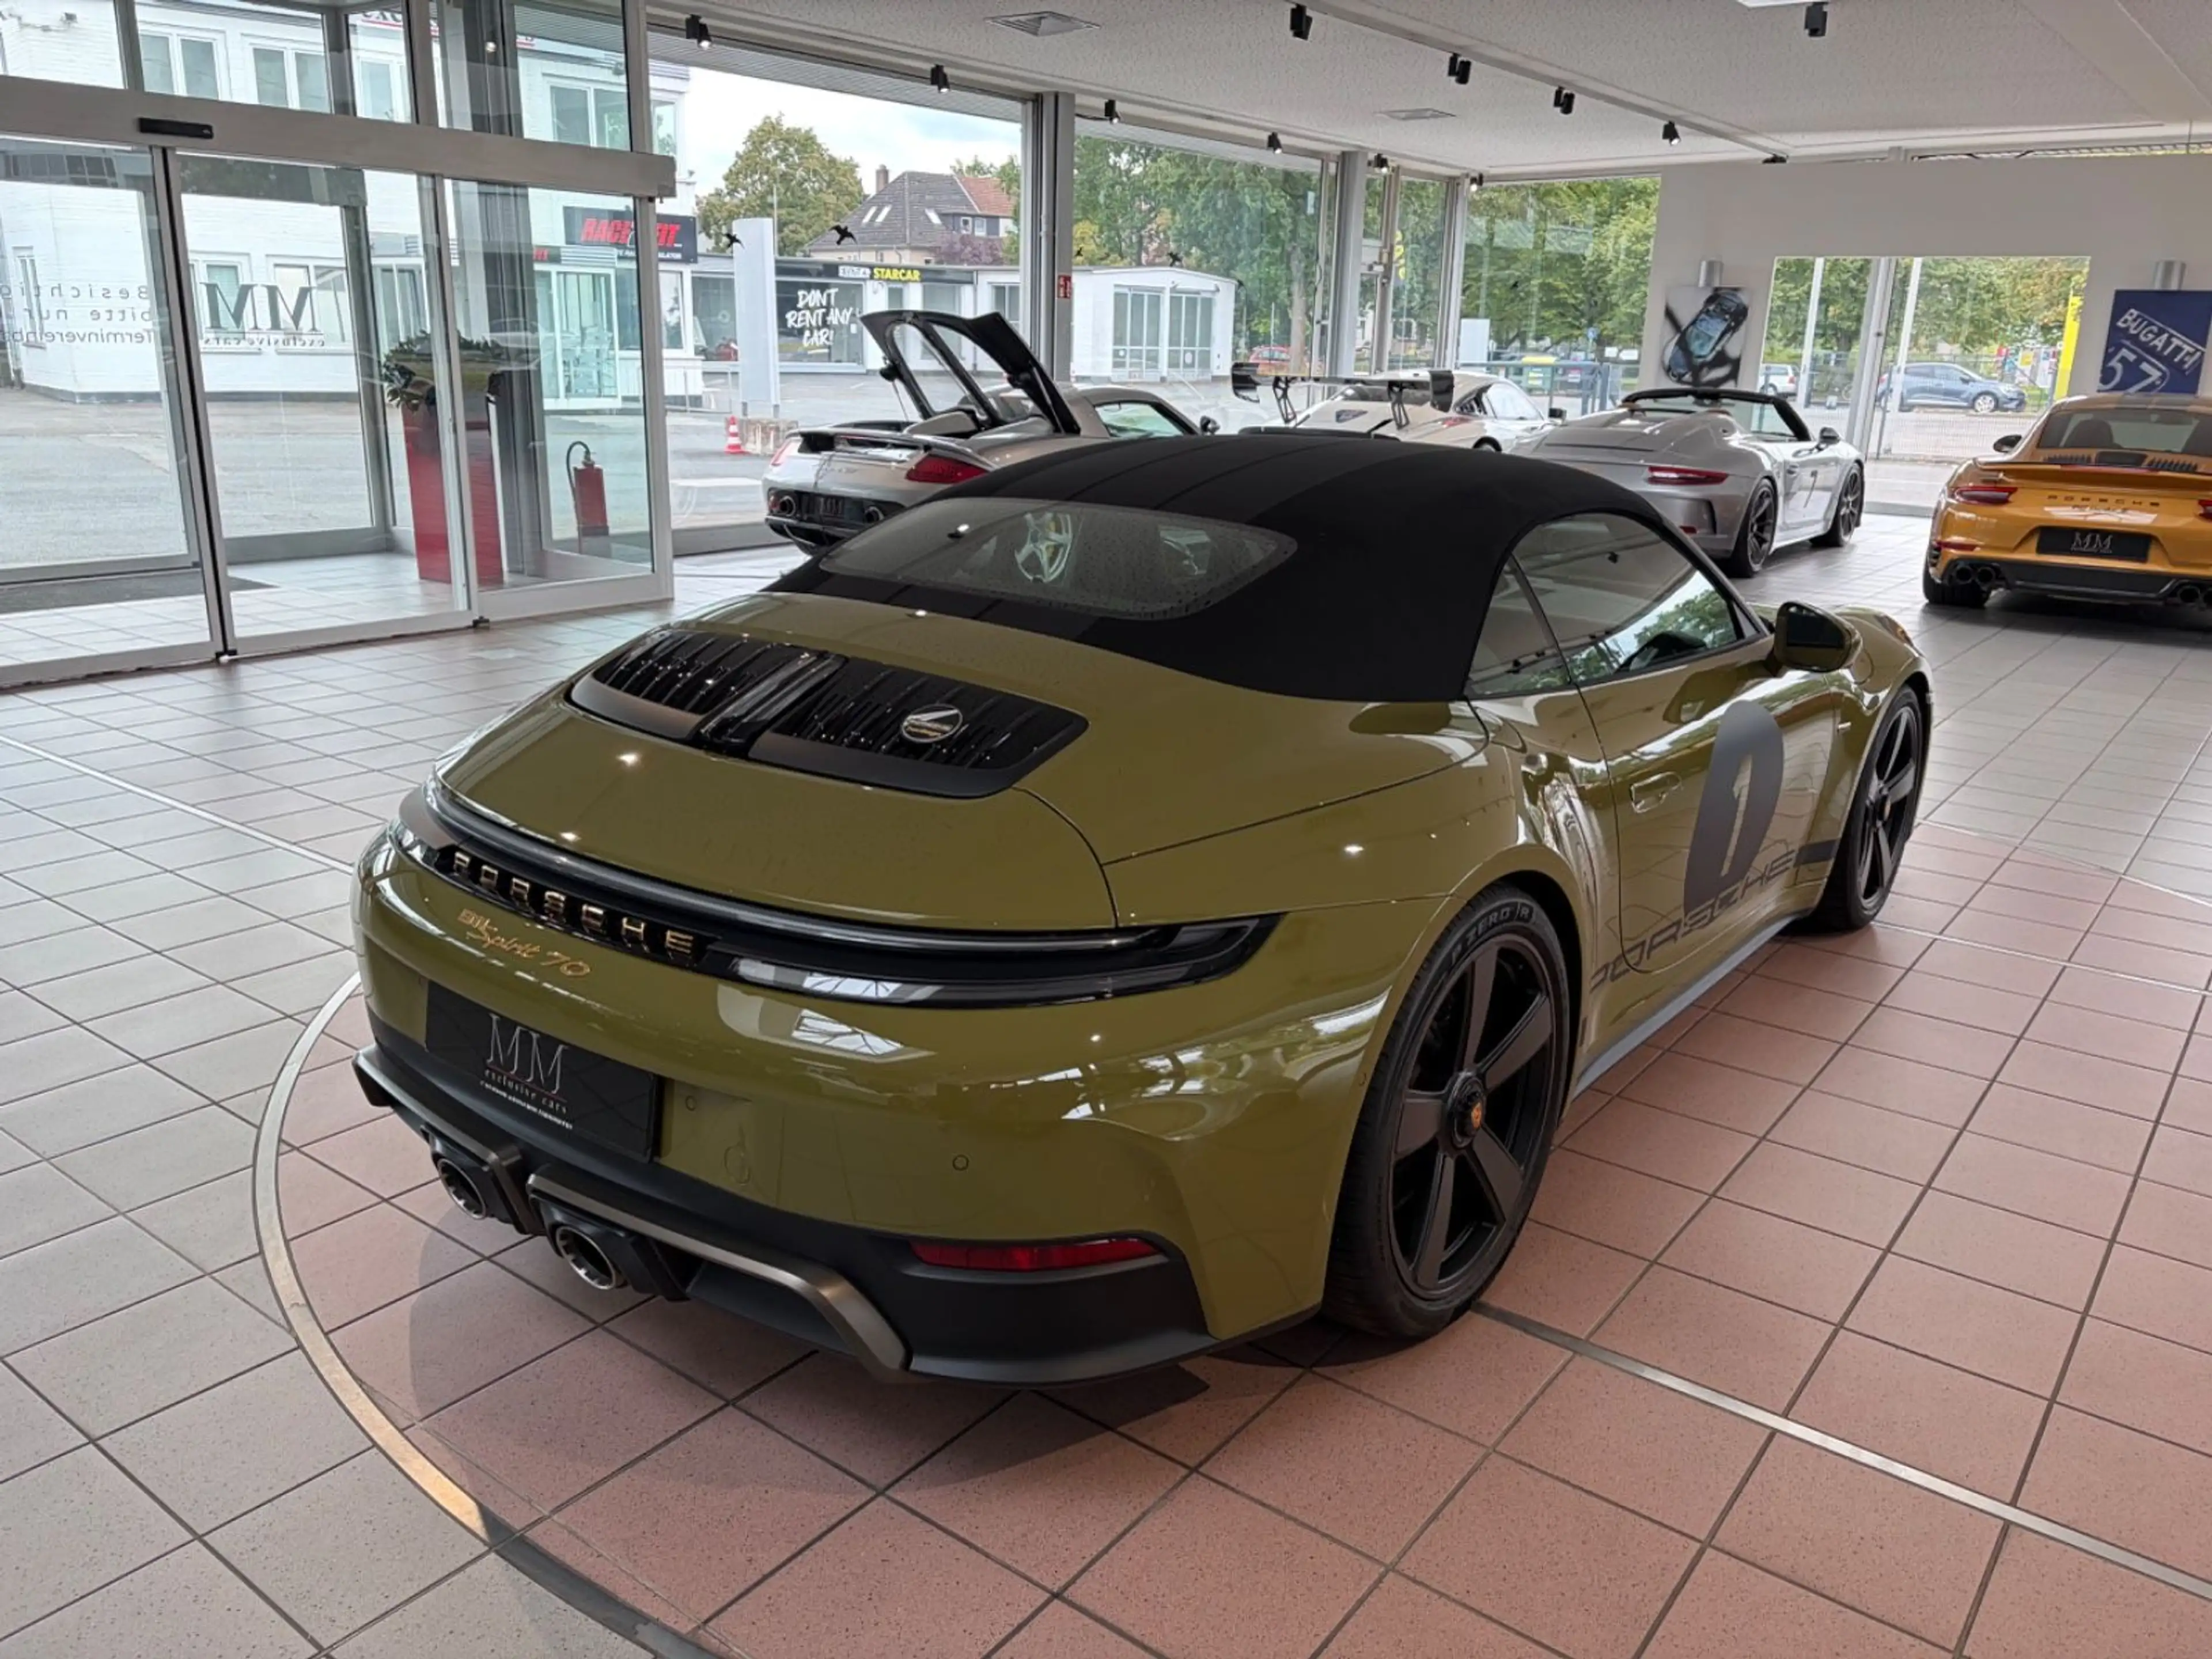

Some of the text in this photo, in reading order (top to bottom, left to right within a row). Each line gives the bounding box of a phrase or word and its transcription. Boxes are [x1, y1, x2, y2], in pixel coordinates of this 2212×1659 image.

[873, 267, 921, 282] STARCAR
[796, 287, 839, 308] DONT
[785, 307, 853, 328] RENT ANY
[802, 328, 834, 348] CAR!
[2115, 307, 2202, 370] BUGATTI
[453, 850, 694, 954] PORSCHE
[539, 950, 590, 976] 70
[485, 1013, 569, 1094] MM
[541, 1097, 567, 1115] cars
